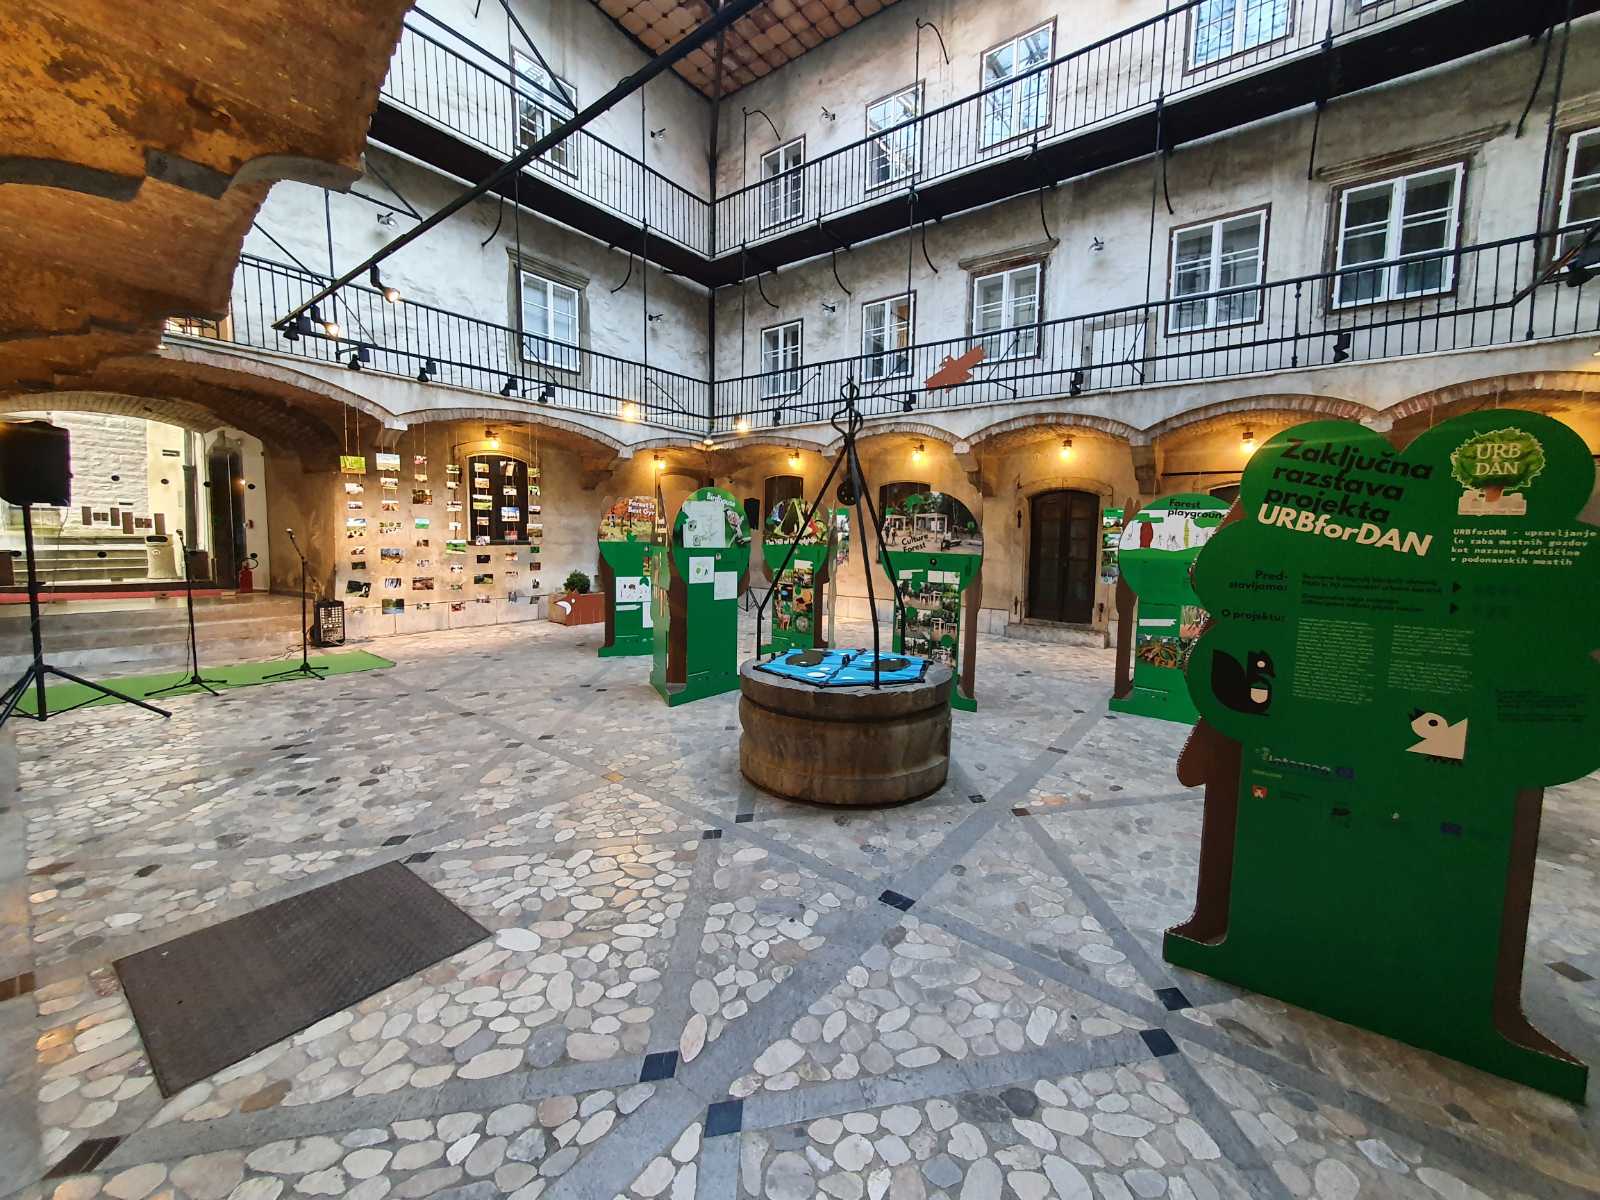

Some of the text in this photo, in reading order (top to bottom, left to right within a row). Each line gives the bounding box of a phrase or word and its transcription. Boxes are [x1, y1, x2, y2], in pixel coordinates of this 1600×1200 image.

[1280, 438, 1433, 480] Zaključna
[1475, 443, 1521, 459] URB
[1472, 461, 1520, 475] DAN
[1272, 466, 1404, 501] razstava
[1169, 499, 1200, 508] Forest
[1263, 488, 1391, 523] projekta
[1257, 503, 1433, 556] URBforDAN
[902, 533, 929, 547] Culture
[903, 542, 926, 553] Forest
